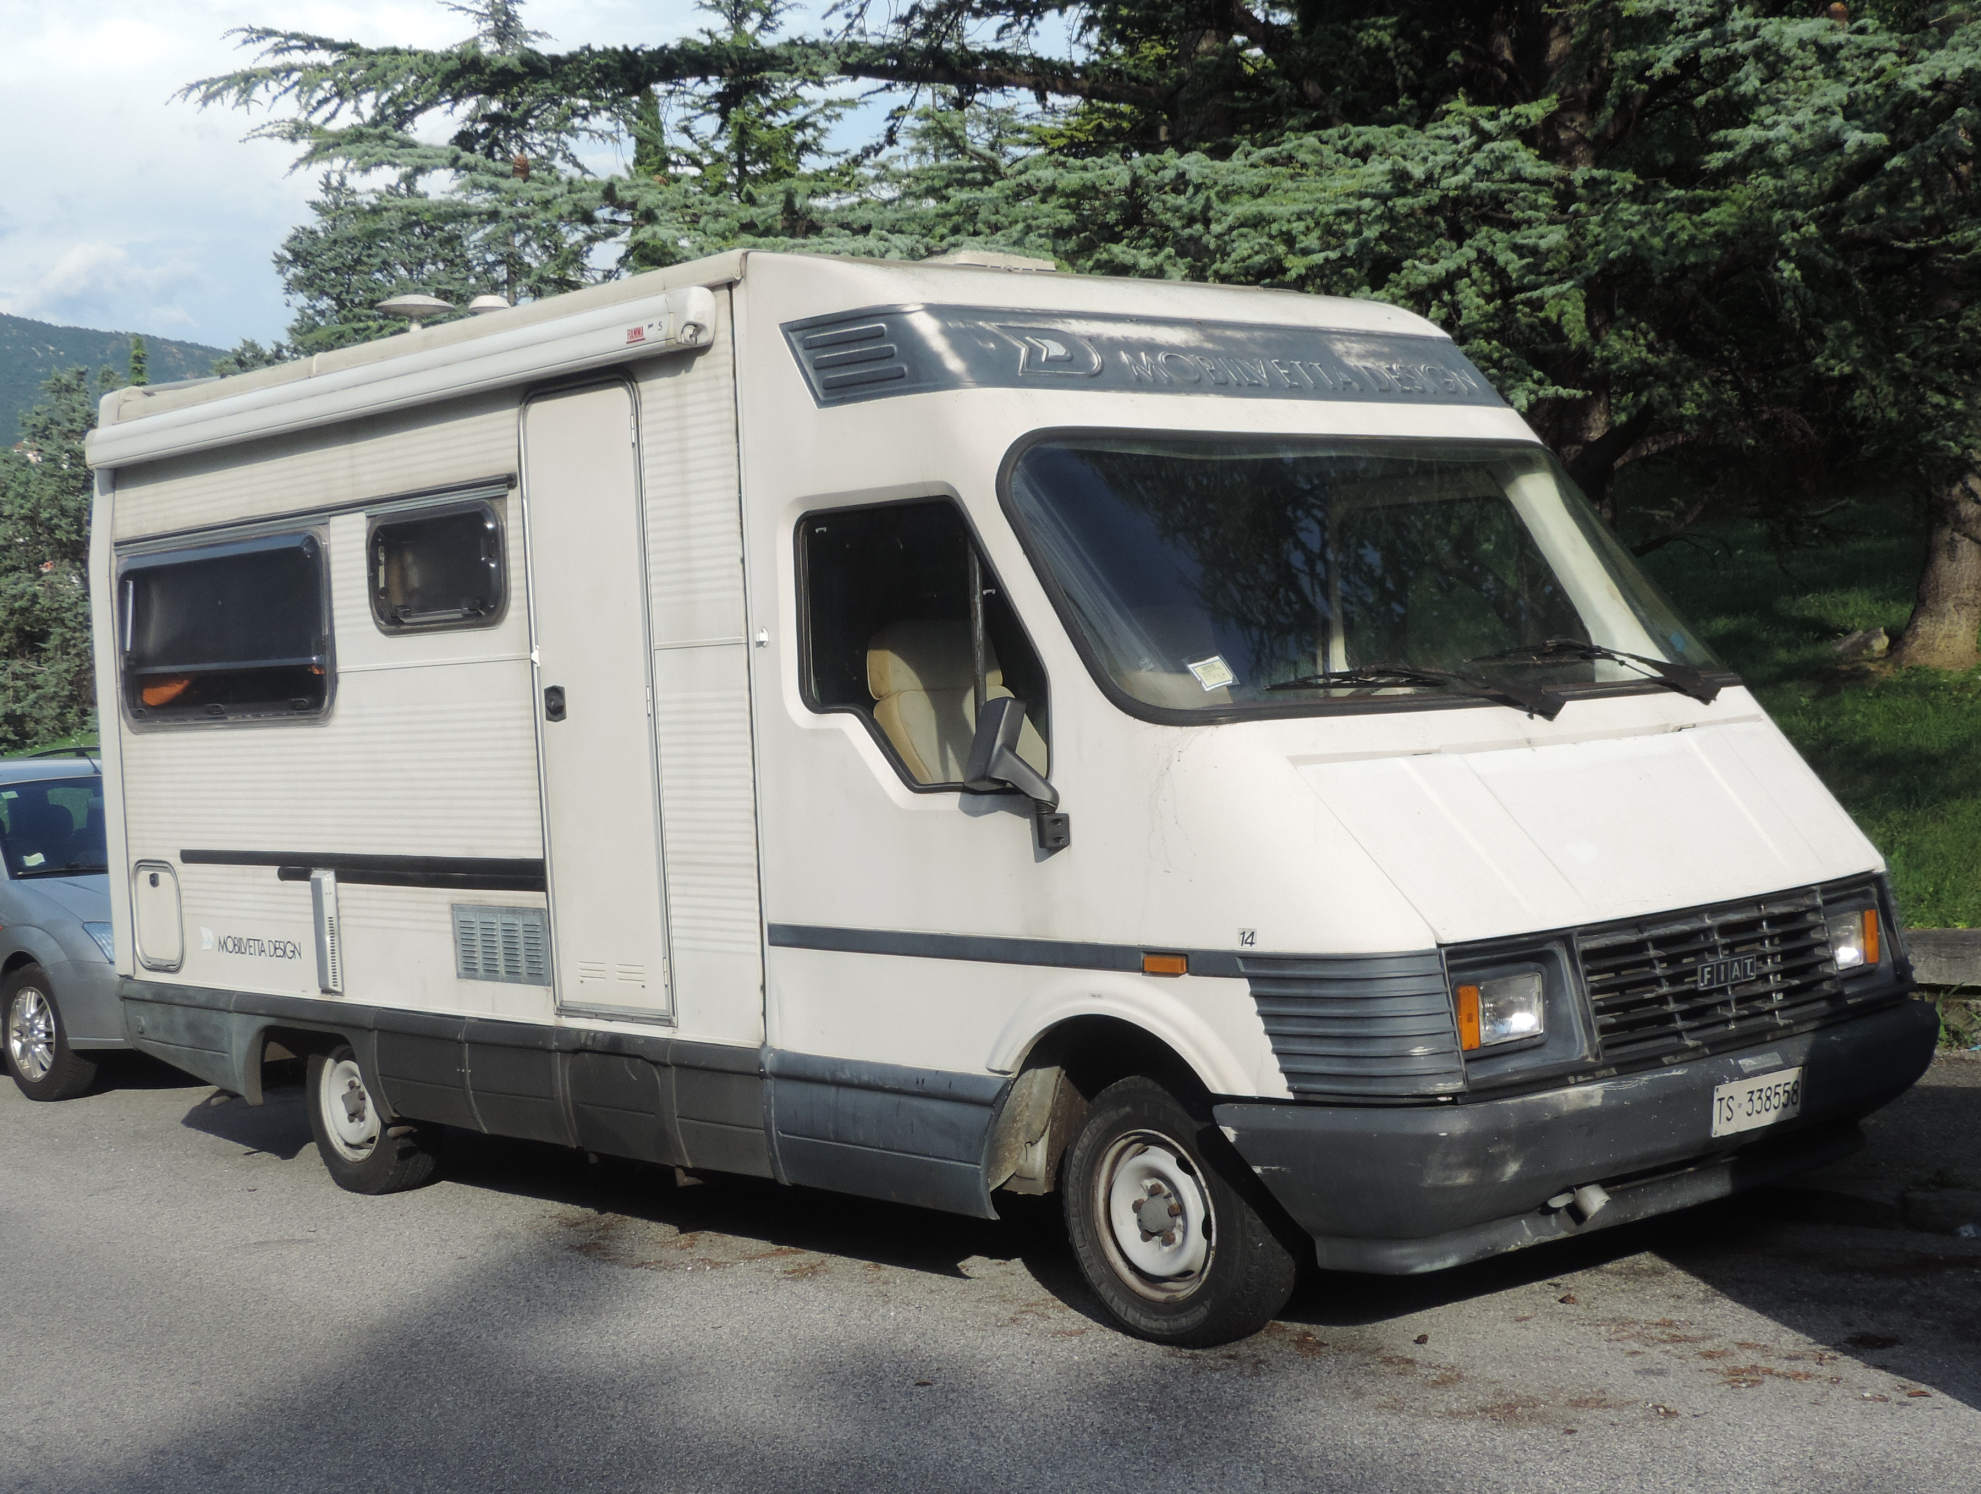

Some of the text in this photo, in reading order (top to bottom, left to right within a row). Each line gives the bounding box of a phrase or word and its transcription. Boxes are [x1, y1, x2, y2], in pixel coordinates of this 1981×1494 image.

[1119, 350, 1480, 394] MOBILVETTA DESIGN
[218, 936, 302, 959] MOBILVETTA DESIGN
[1240, 931, 1255, 947] 14
[1703, 958, 1753, 985] FIAT
[1717, 1080, 1800, 1125] TS 338558
